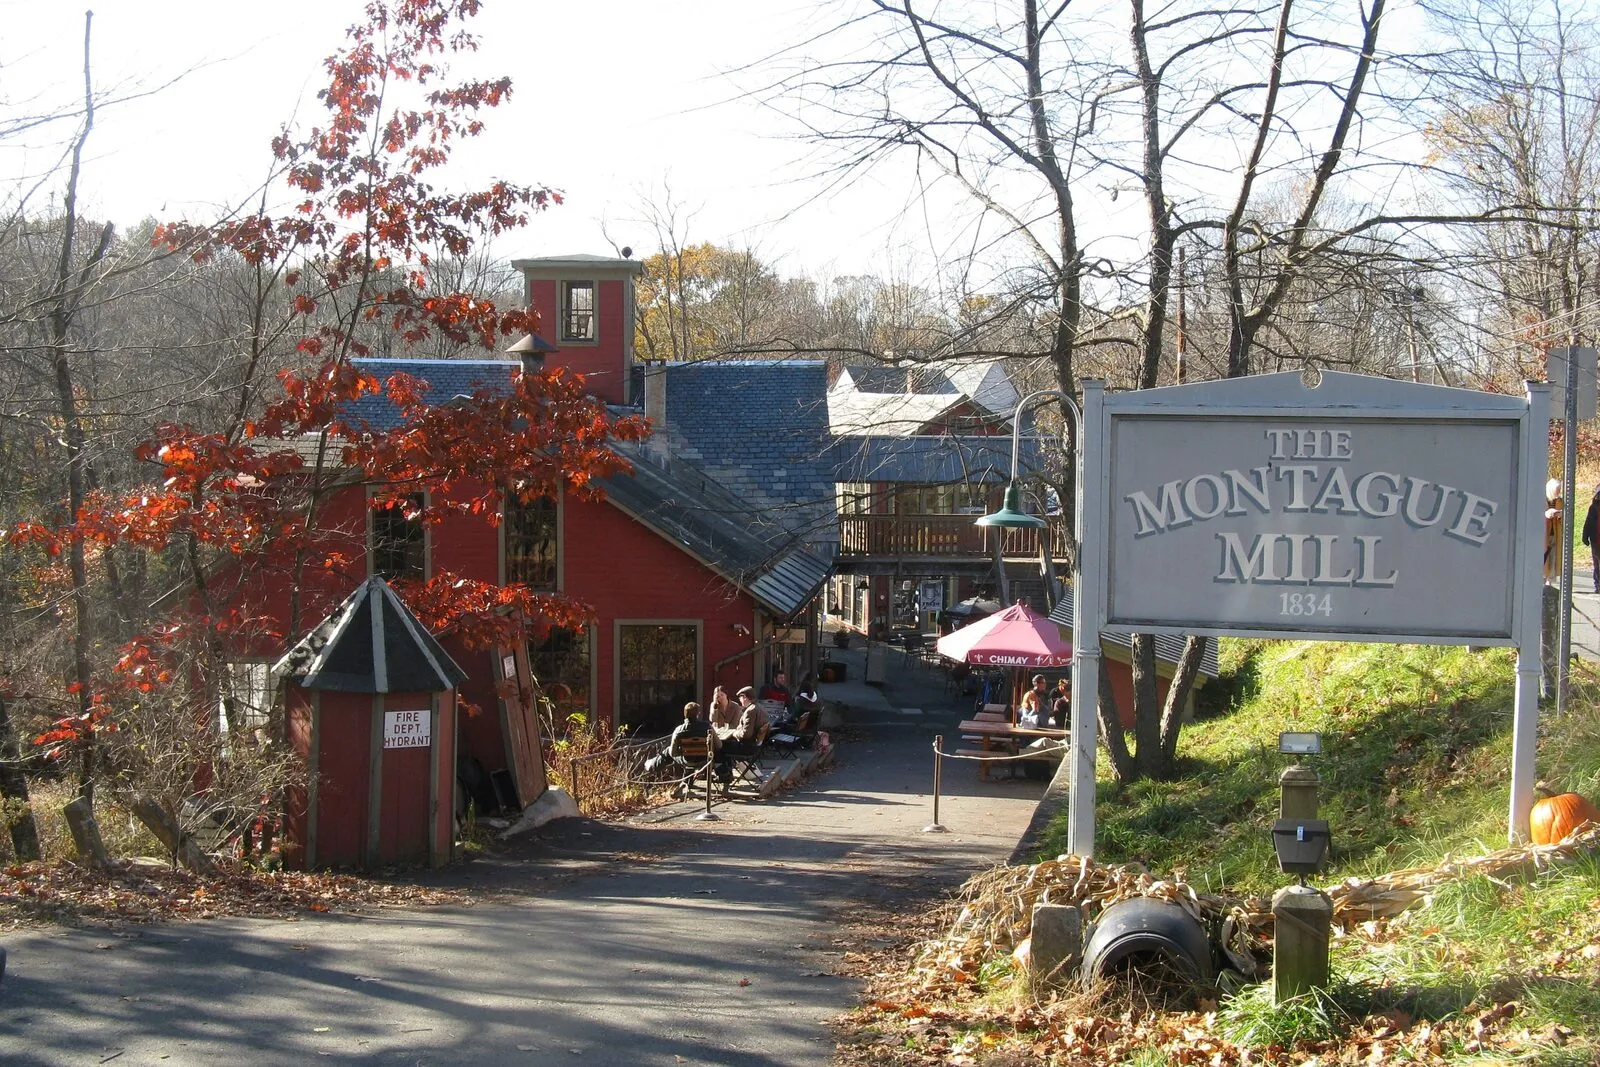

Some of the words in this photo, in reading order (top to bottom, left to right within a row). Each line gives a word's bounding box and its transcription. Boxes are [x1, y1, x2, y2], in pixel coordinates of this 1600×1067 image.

[1264, 429, 1353, 462] THE
[1124, 465, 1498, 547] MONTAGUE
[1213, 531, 1399, 588] MILL
[1280, 592, 1332, 616] 1834
[989, 655, 1029, 665] CHIMAY
[396, 712, 419, 722] FIRE
[394, 724, 422, 734] DEPT.
[384, 736, 430, 747] HYDRANT
